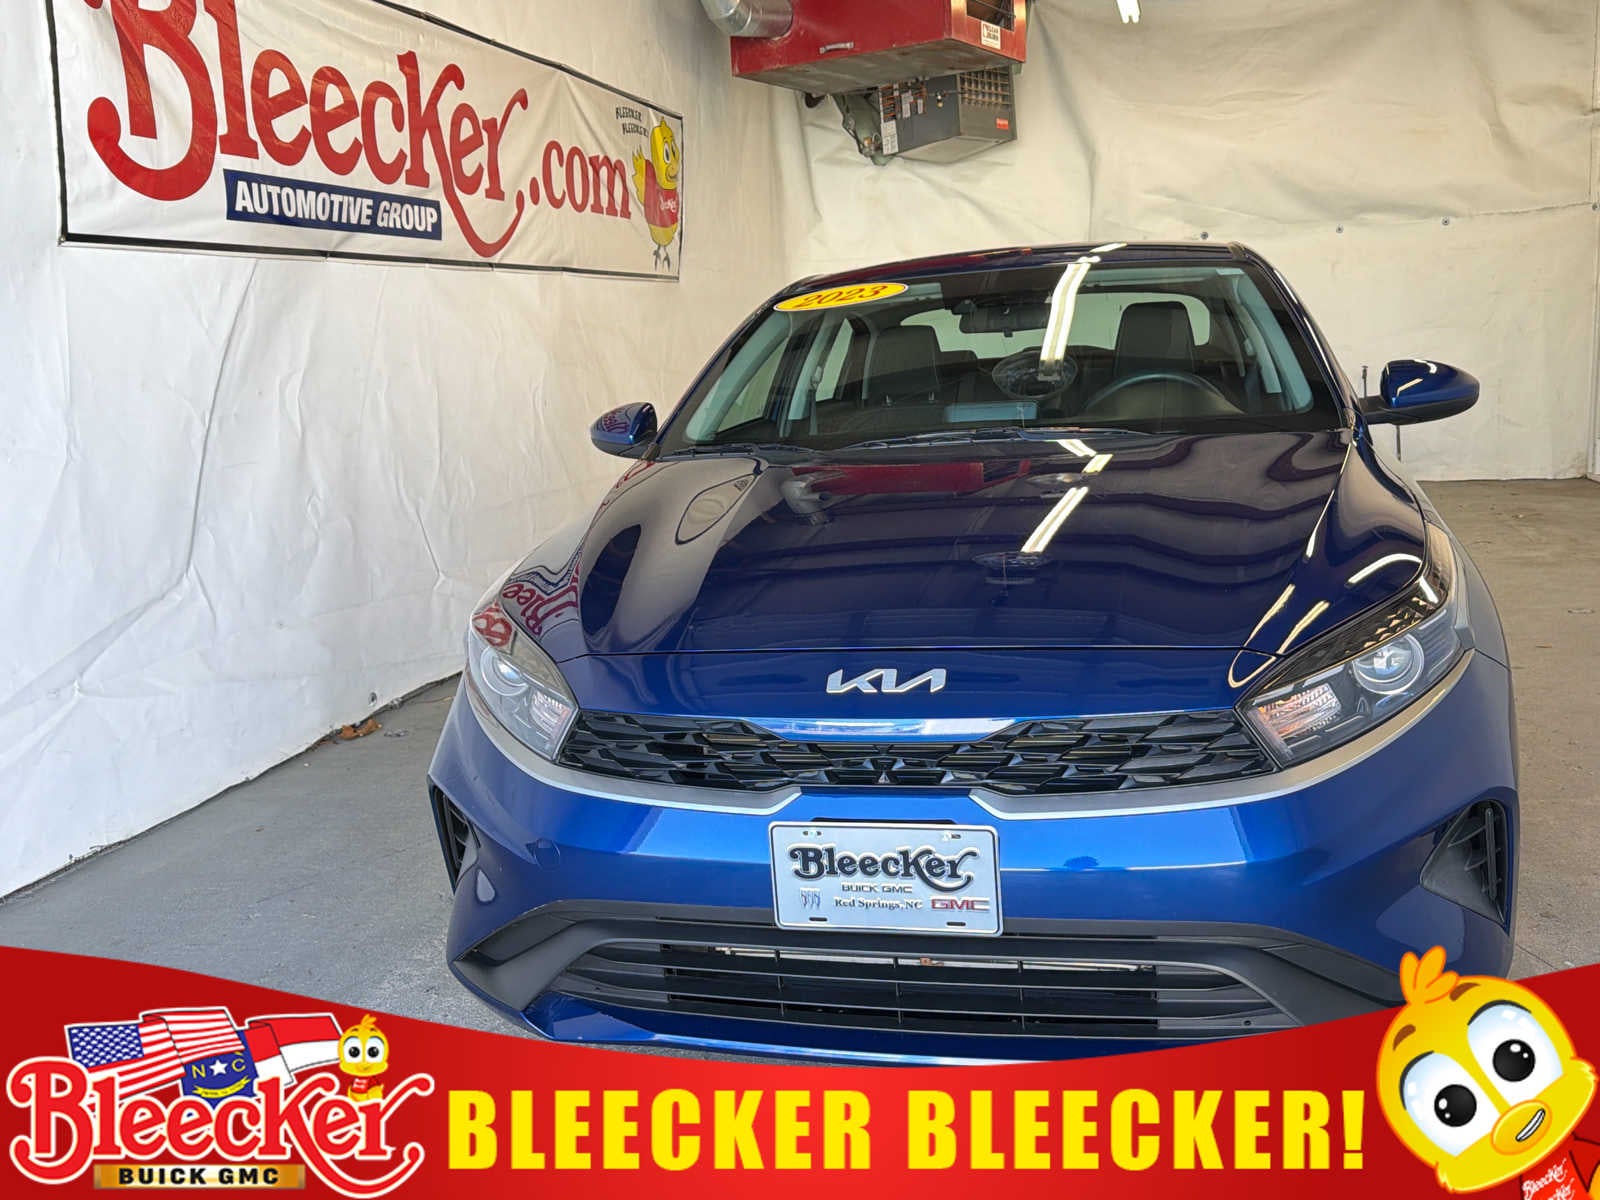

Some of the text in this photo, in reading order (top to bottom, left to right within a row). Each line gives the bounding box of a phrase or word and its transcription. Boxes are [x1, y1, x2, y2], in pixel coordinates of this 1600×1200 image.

[235, 180, 438, 232] AUTOMOTIVE GROUP
[793, 284, 888, 309] 2023
[841, 883, 913, 894] BUICK GMC
[834, 898, 856, 907] Red
[931, 898, 990, 911] GMC
